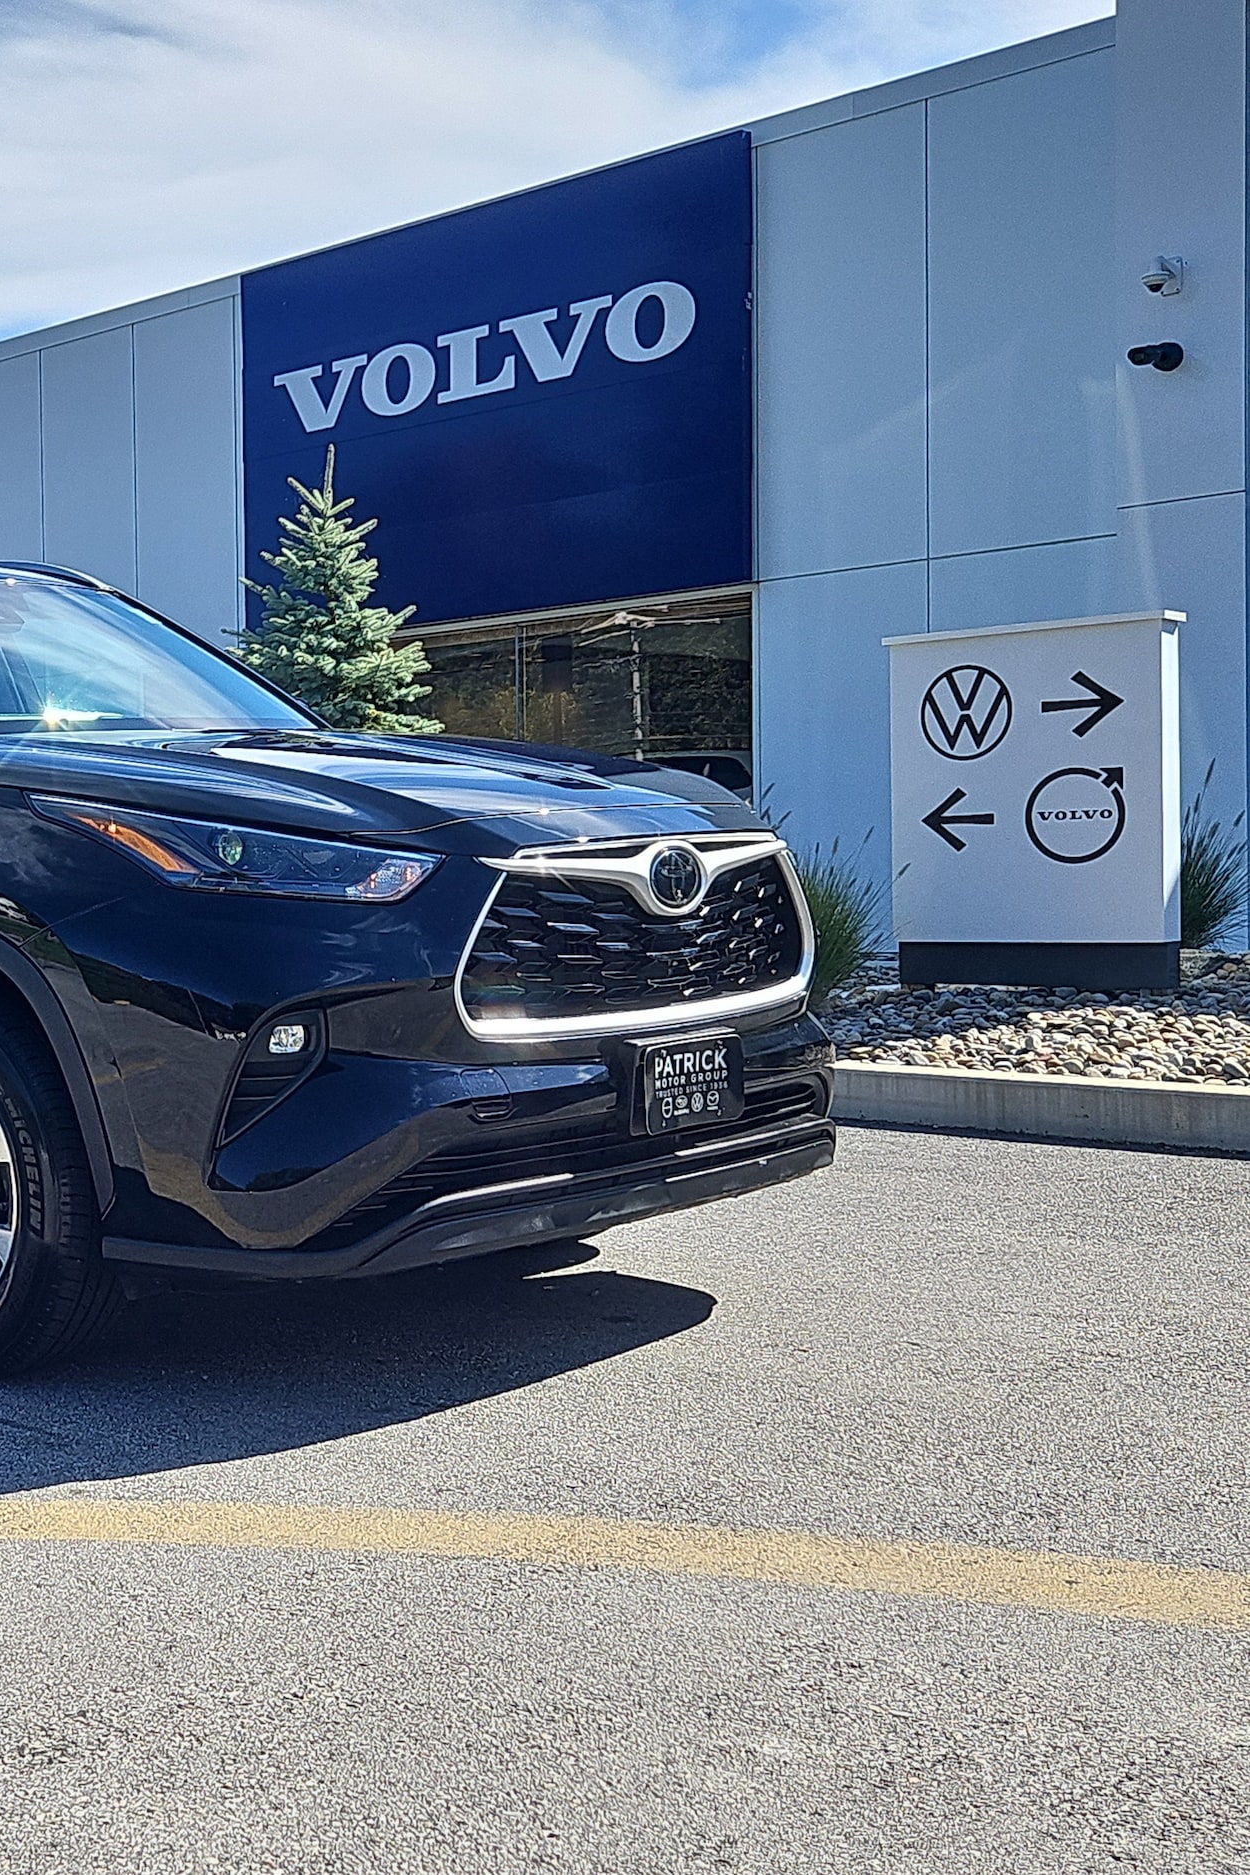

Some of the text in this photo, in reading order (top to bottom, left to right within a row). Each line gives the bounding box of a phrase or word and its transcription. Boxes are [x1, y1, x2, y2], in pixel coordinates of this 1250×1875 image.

[273, 280, 697, 433] VOLVO
[1037, 808, 1114, 821] VOLVO
[655, 1048, 727, 1079] PATRICK
[655, 1070, 728, 1089] MOTOR GROUP
[656, 1087, 683, 1098] TRUSTED
[686, 1083, 707, 1093] SINCE
[5, 1097, 44, 1239] MICHELIN
